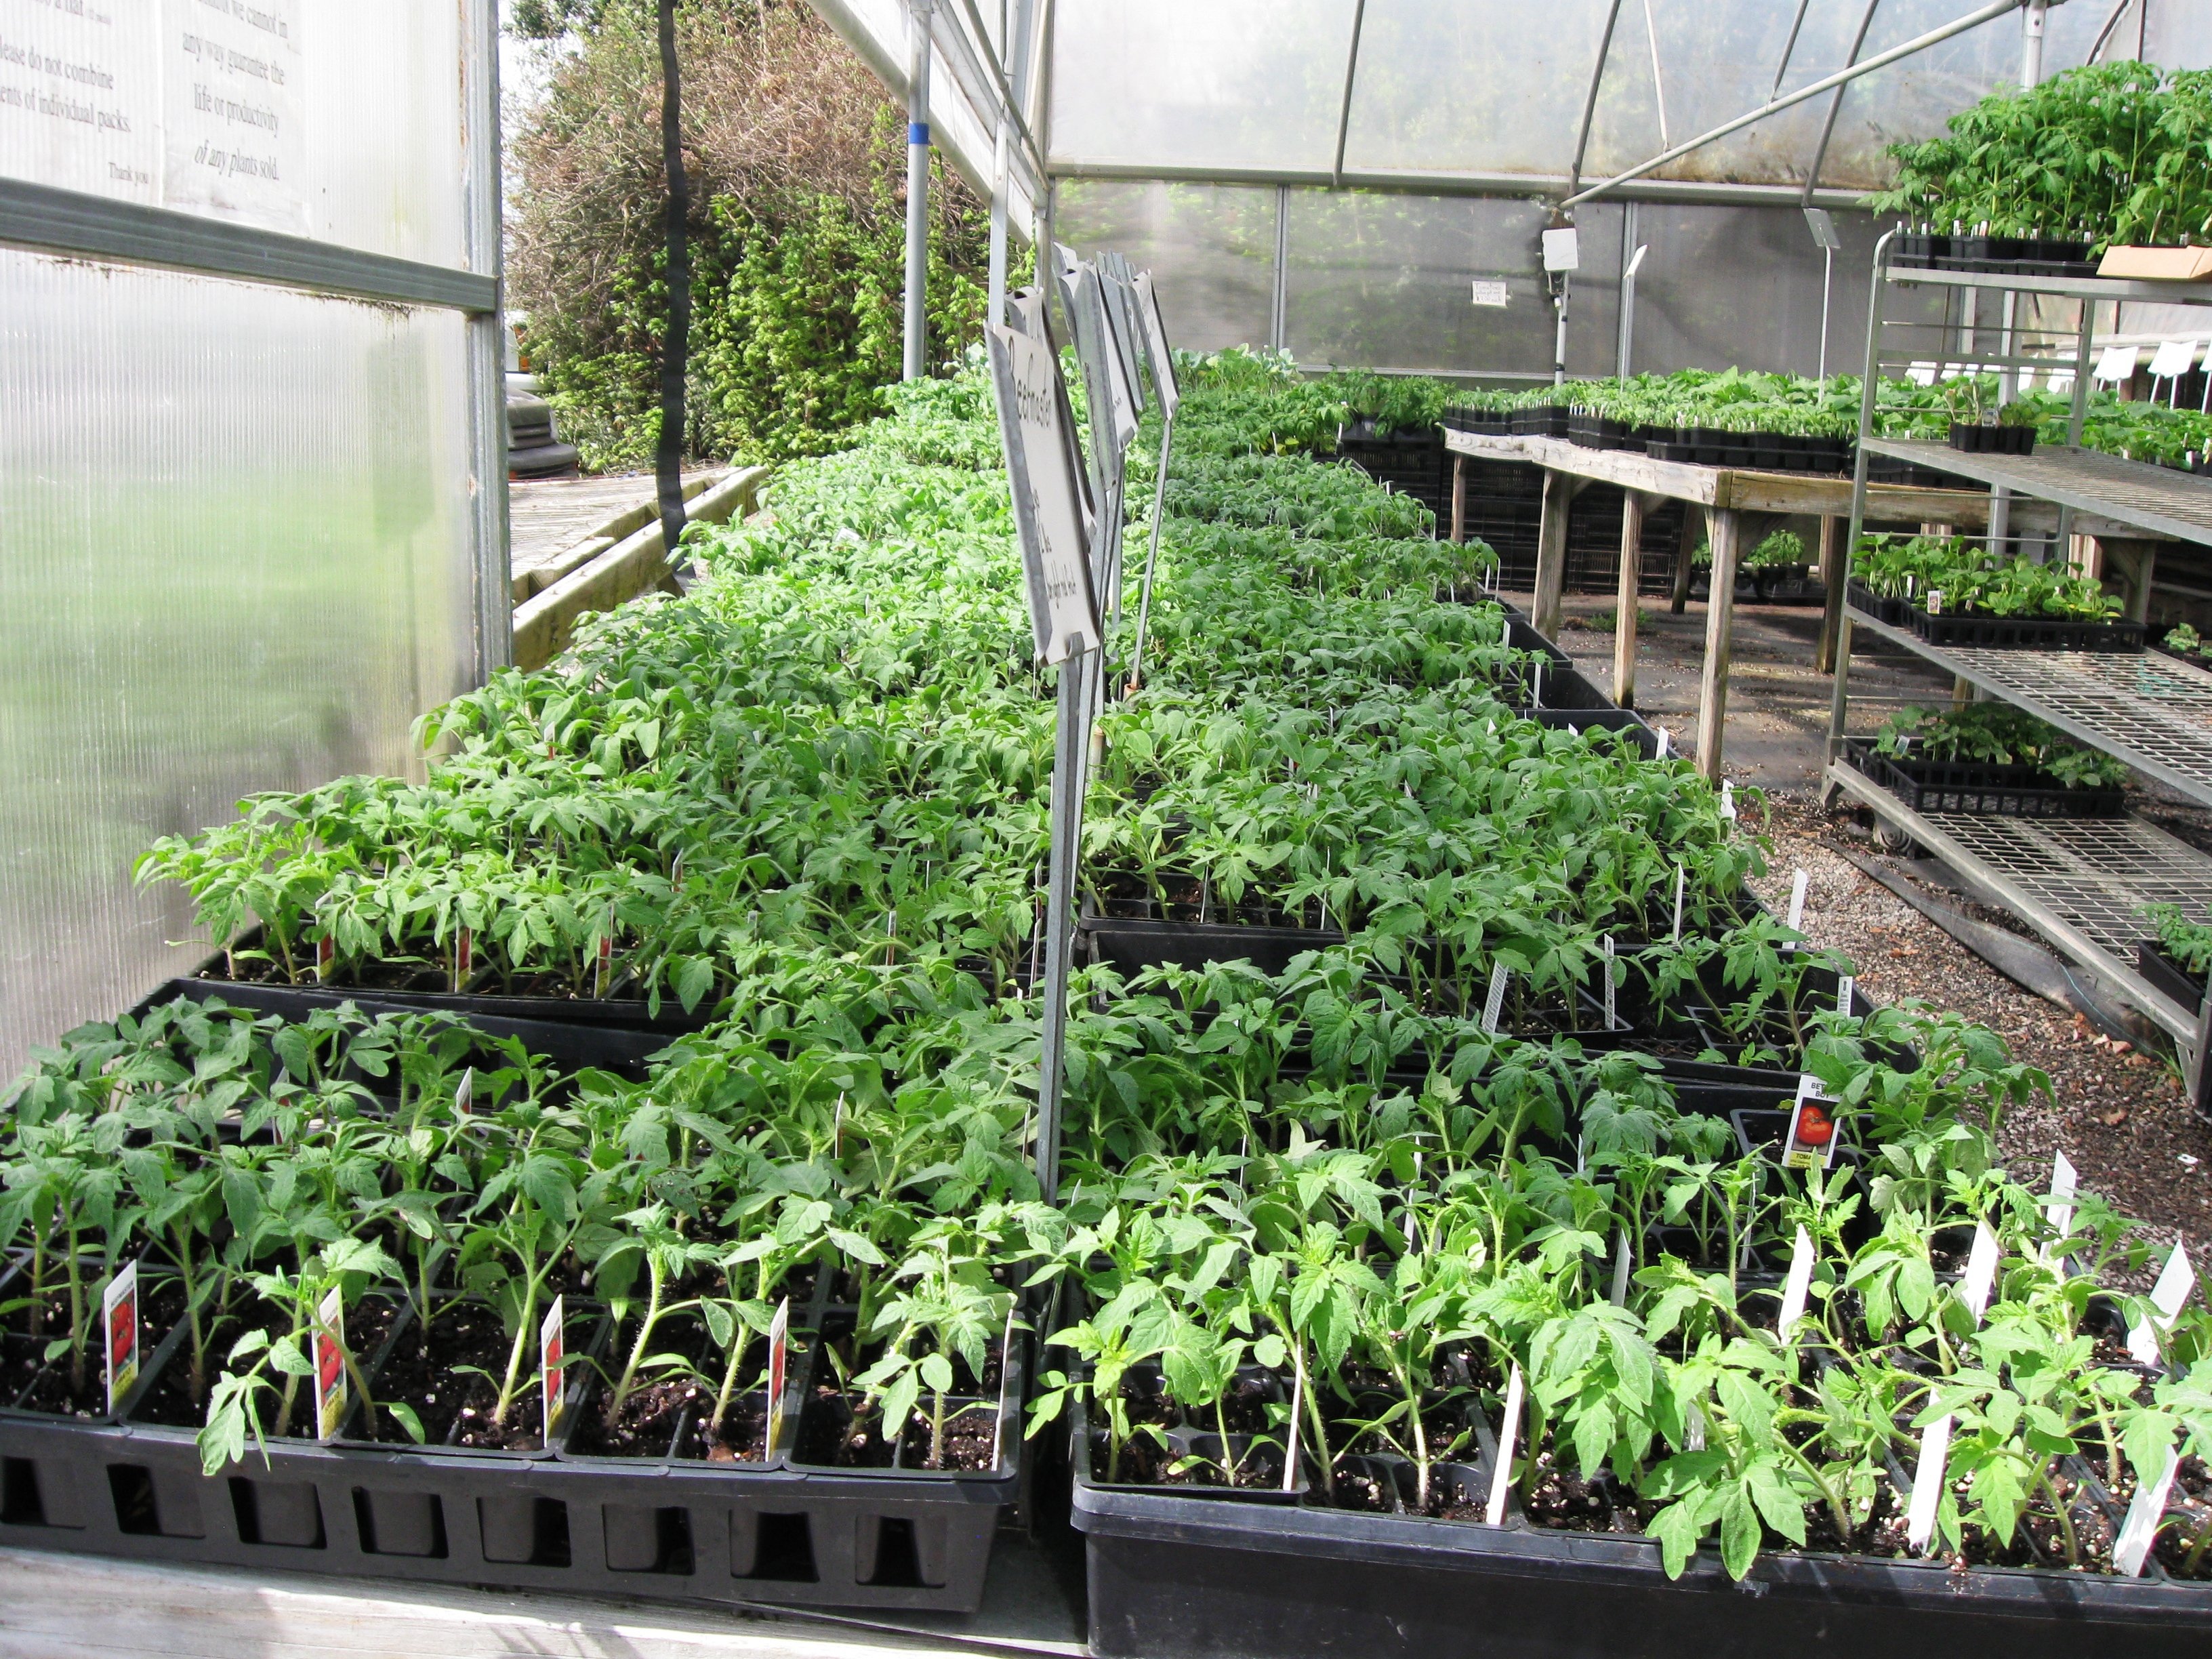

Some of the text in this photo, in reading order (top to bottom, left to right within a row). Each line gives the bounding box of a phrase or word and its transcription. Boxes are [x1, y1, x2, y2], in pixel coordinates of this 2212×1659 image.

[247, 7, 276, 34] cannot
[279, 12, 288, 39] in
[28, 46, 42, 71] do
[45, 57, 62, 76] not
[65, 62, 114, 90] combine
[182, 33, 203, 62] any
[204, 40, 225, 70] way
[270, 60, 285, 85] the
[24, 87, 36, 110] of
[38, 89, 94, 125] individual
[194, 83, 279, 138] life or productivity
[108, 162, 149, 186] Thank you
[194, 139, 279, 181] of any plants sold.
